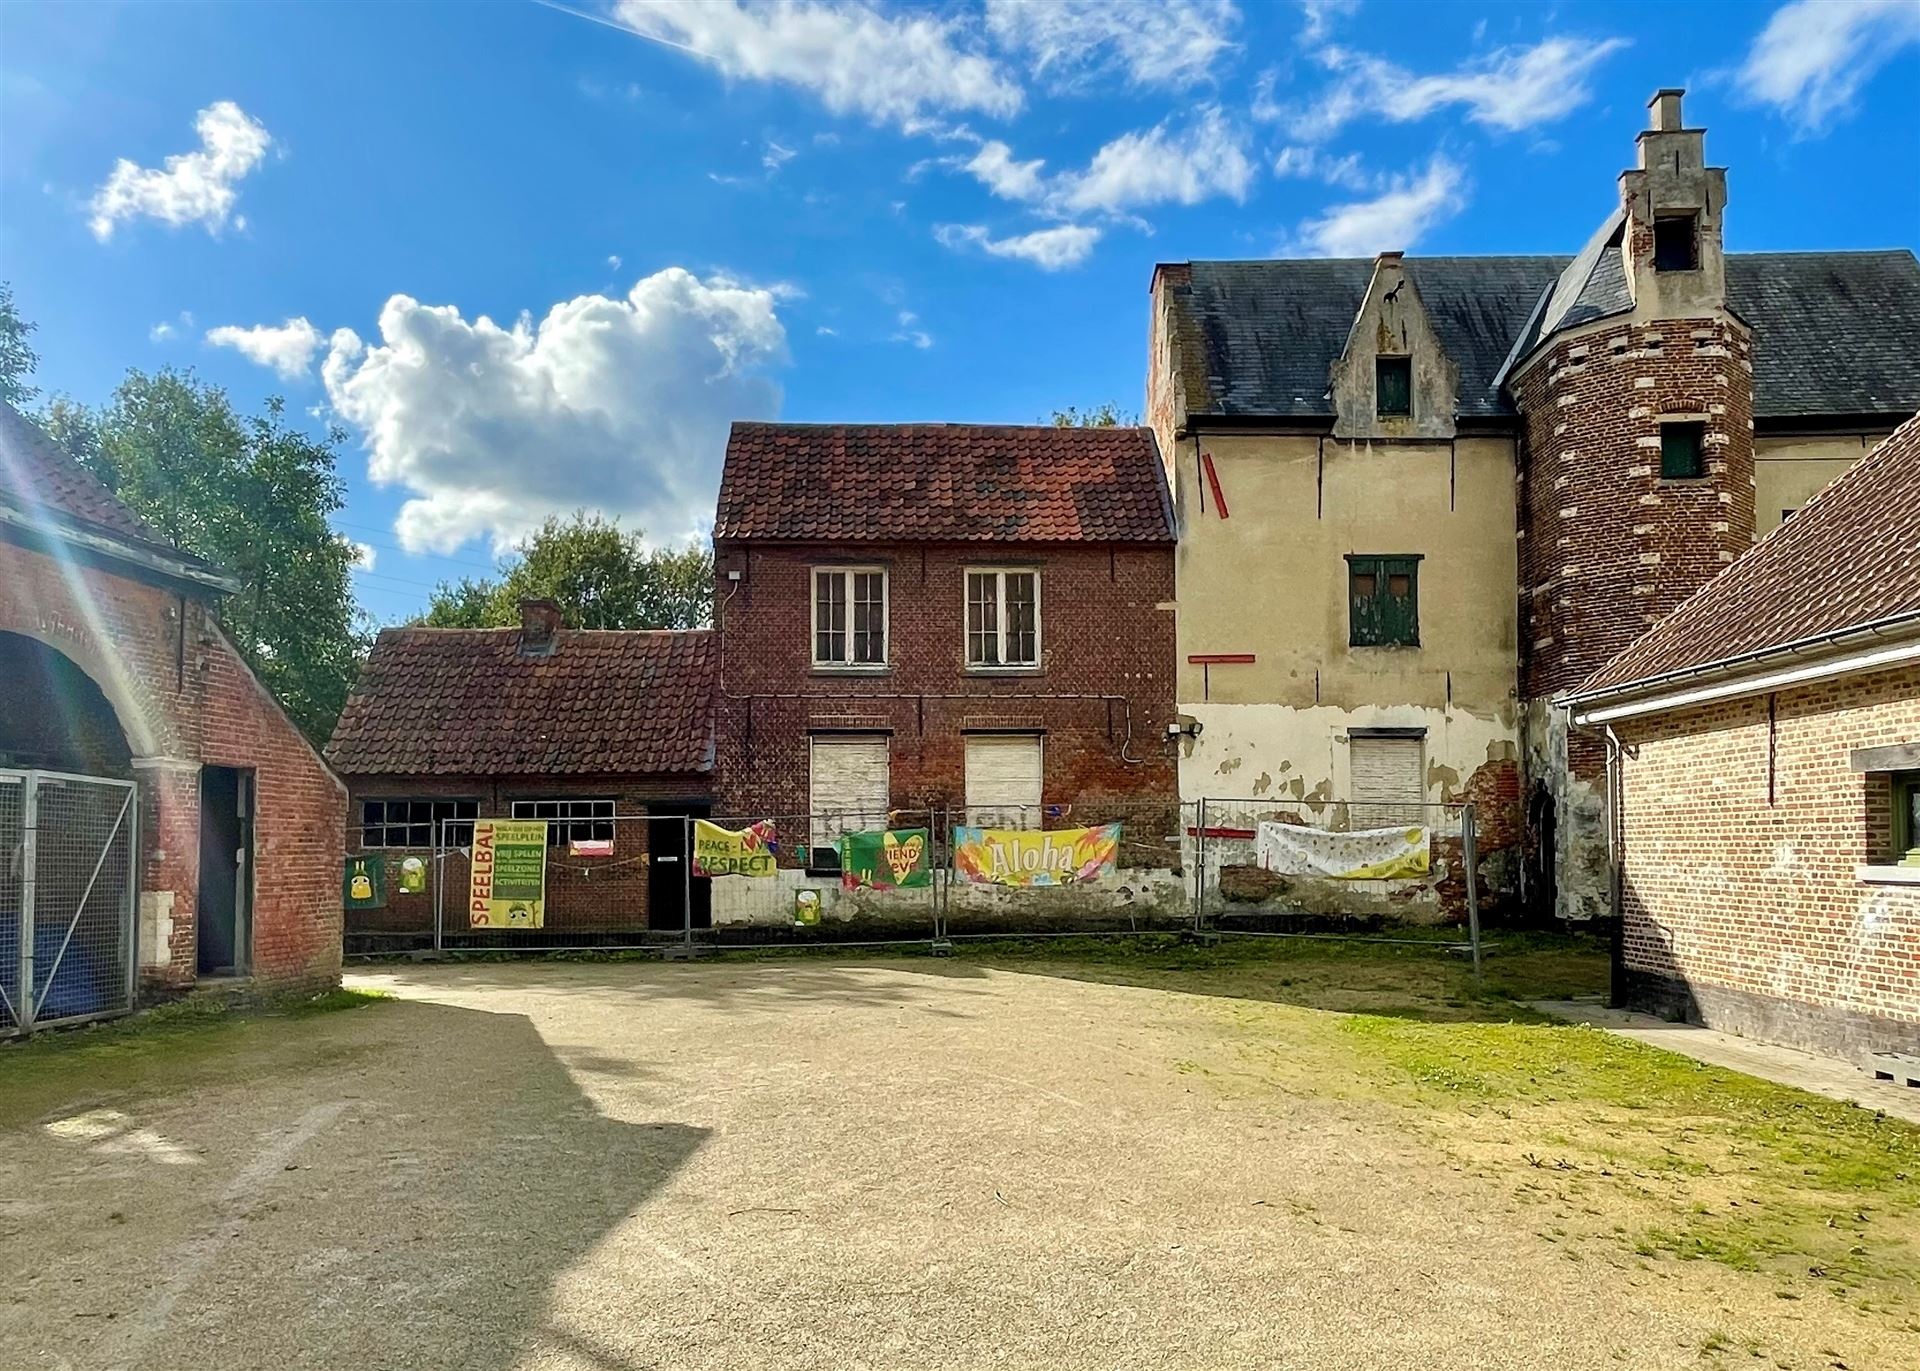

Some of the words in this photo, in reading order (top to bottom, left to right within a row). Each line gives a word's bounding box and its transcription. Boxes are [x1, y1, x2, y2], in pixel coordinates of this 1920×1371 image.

[496, 832, 545, 841] SPEELPLEIN
[699, 840, 730, 852] PEACE
[495, 850, 511, 858] VRIJ
[991, 836, 1075, 876] Aloha
[699, 855, 771, 873] RESPECT
[472, 823, 493, 925] SPEELBAL
